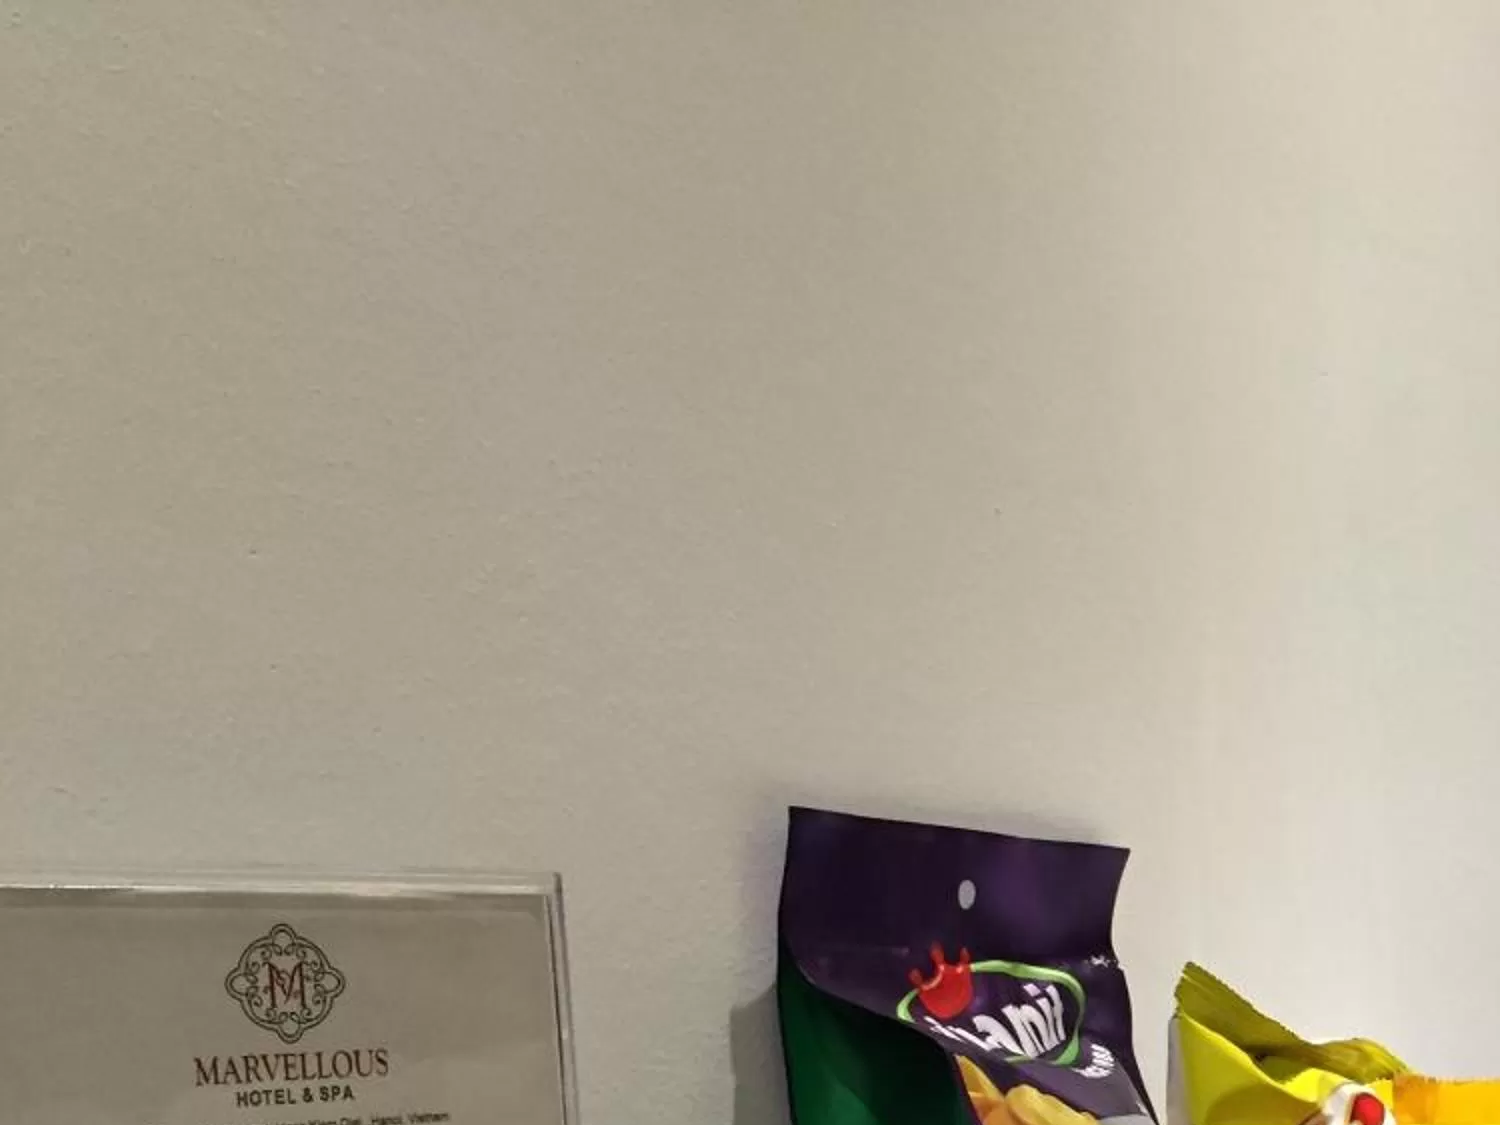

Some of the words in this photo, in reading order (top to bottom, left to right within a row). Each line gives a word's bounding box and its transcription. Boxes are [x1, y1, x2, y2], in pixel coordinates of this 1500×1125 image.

[194, 1048, 390, 1087] MARVELLOUS
[236, 1088, 296, 1108] HOTEL
[302, 1085, 314, 1102] &
[319, 1085, 354, 1102] SPA
